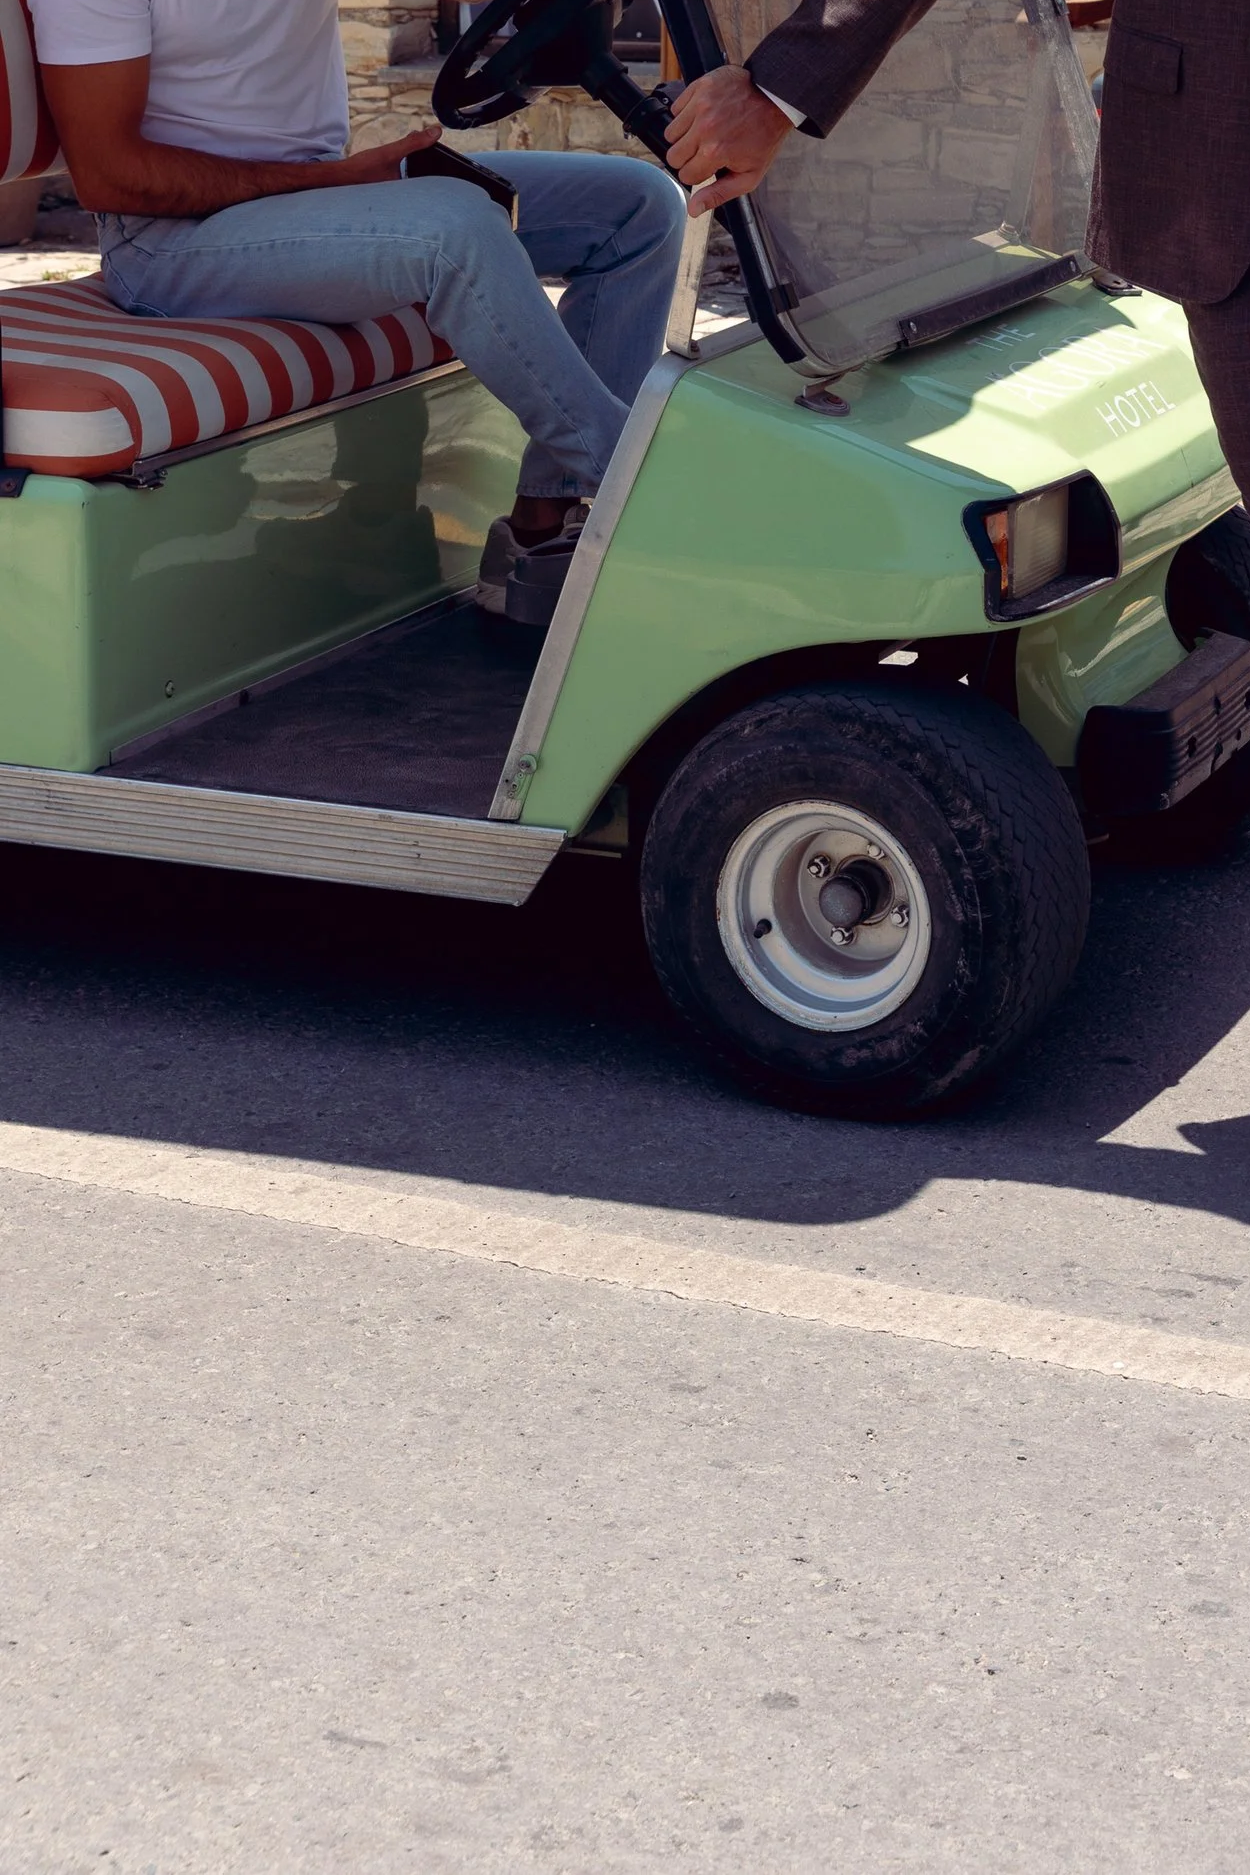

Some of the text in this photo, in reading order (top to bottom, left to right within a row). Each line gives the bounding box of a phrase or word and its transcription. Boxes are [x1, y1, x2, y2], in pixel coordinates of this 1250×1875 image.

[964, 323, 1036, 351] THE
[984, 326, 1170, 411] AGORA
[1095, 380, 1176, 437] HOTEL
